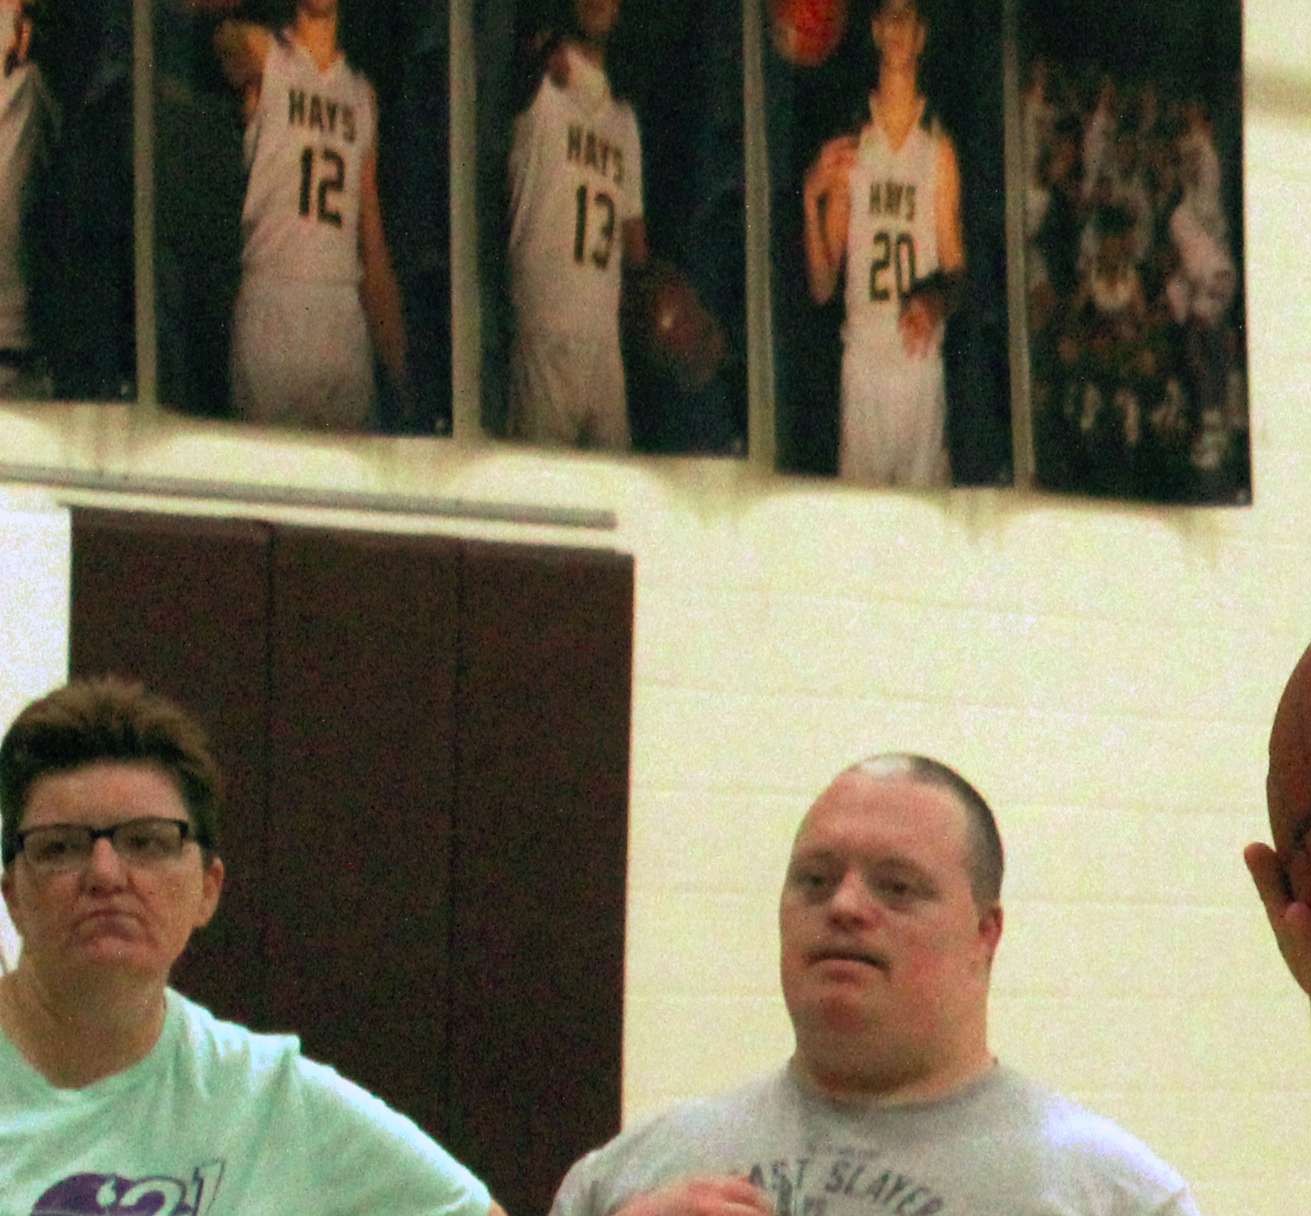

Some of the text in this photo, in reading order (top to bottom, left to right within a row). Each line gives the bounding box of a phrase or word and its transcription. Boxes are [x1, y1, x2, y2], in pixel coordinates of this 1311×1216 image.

[286, 88, 358, 142] HAYS
[297, 146, 347, 228] 12
[566, 123, 626, 184] HAYS
[571, 184, 618, 271] 13
[868, 232, 918, 303] 20
